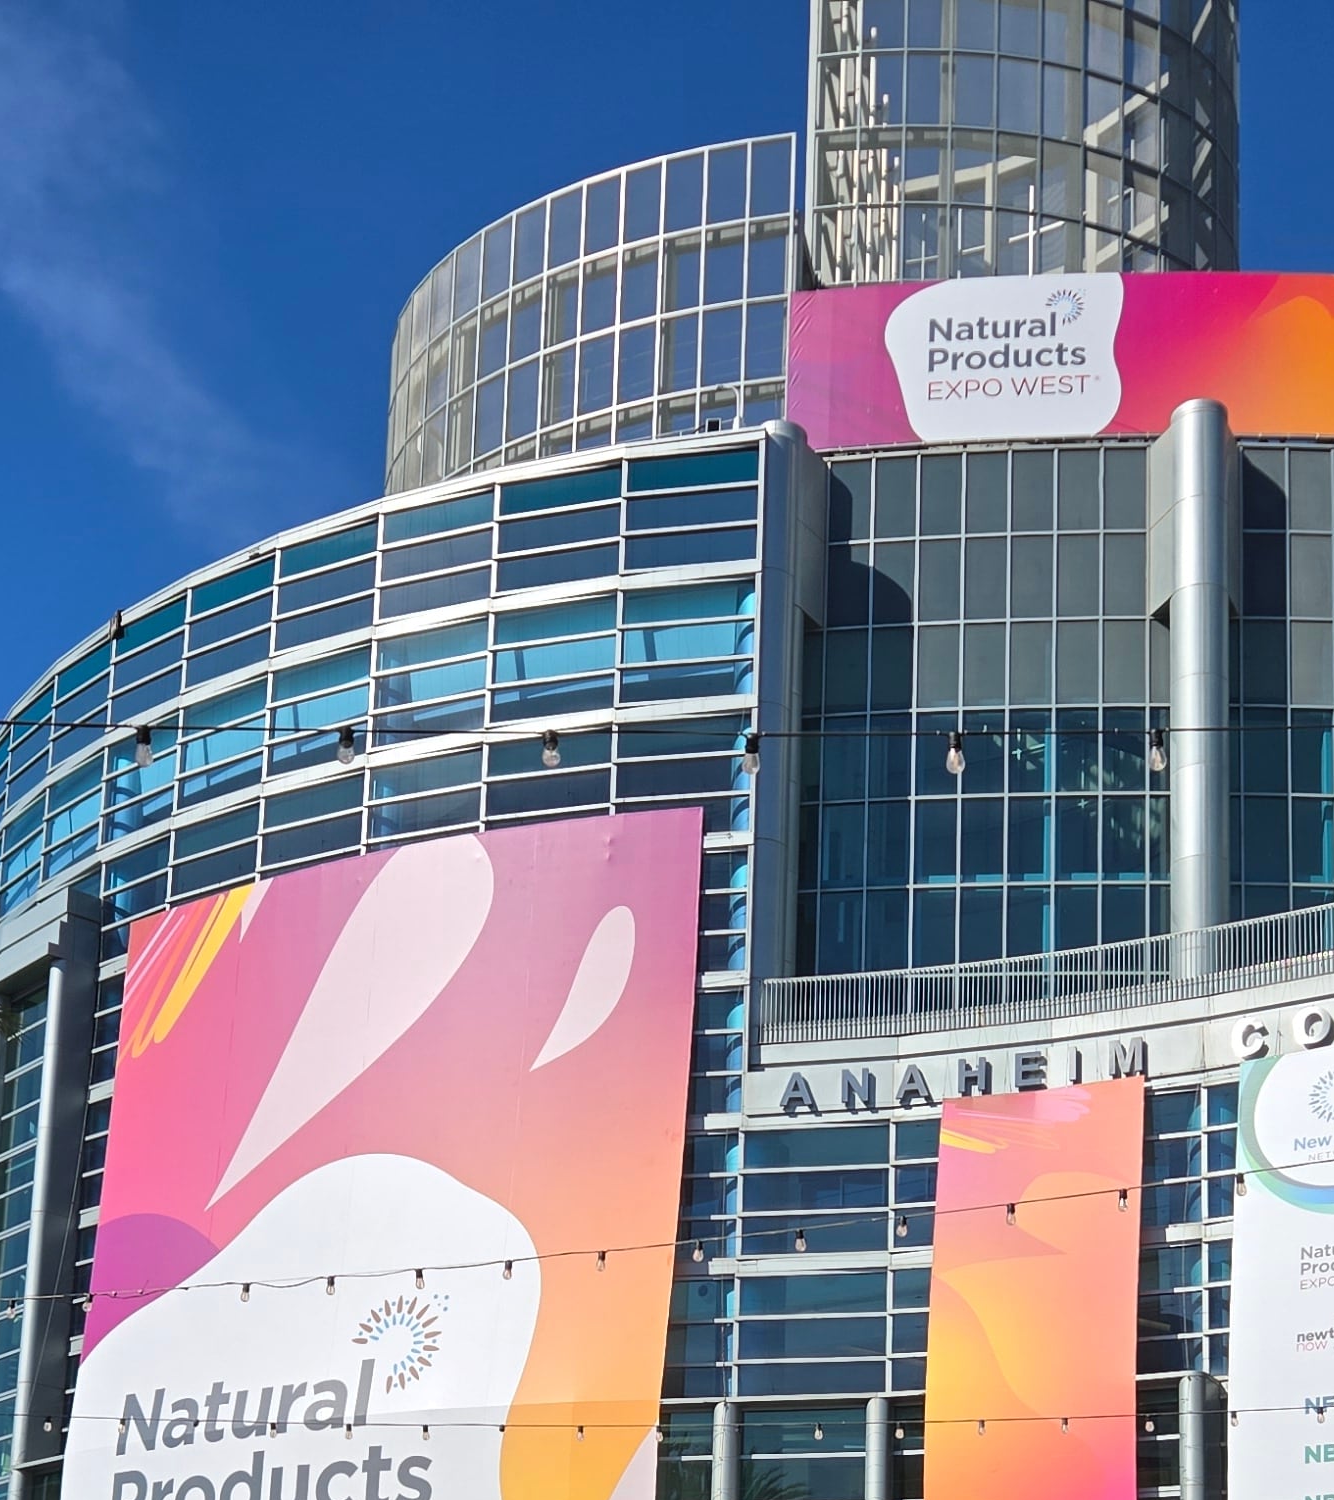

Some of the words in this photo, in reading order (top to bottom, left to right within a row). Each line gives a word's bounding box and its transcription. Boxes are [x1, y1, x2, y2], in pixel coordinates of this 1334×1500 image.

[928, 312, 1059, 343] Natural
[927, 342, 1087, 373] Products
[926, 377, 1006, 401] EXPO
[780, 1036, 1149, 1113] ANAHEIM
[1293, 1135, 1333, 1151] New
[1296, 1341, 1328, 1352] now
[114, 1358, 376, 1456] Natural
